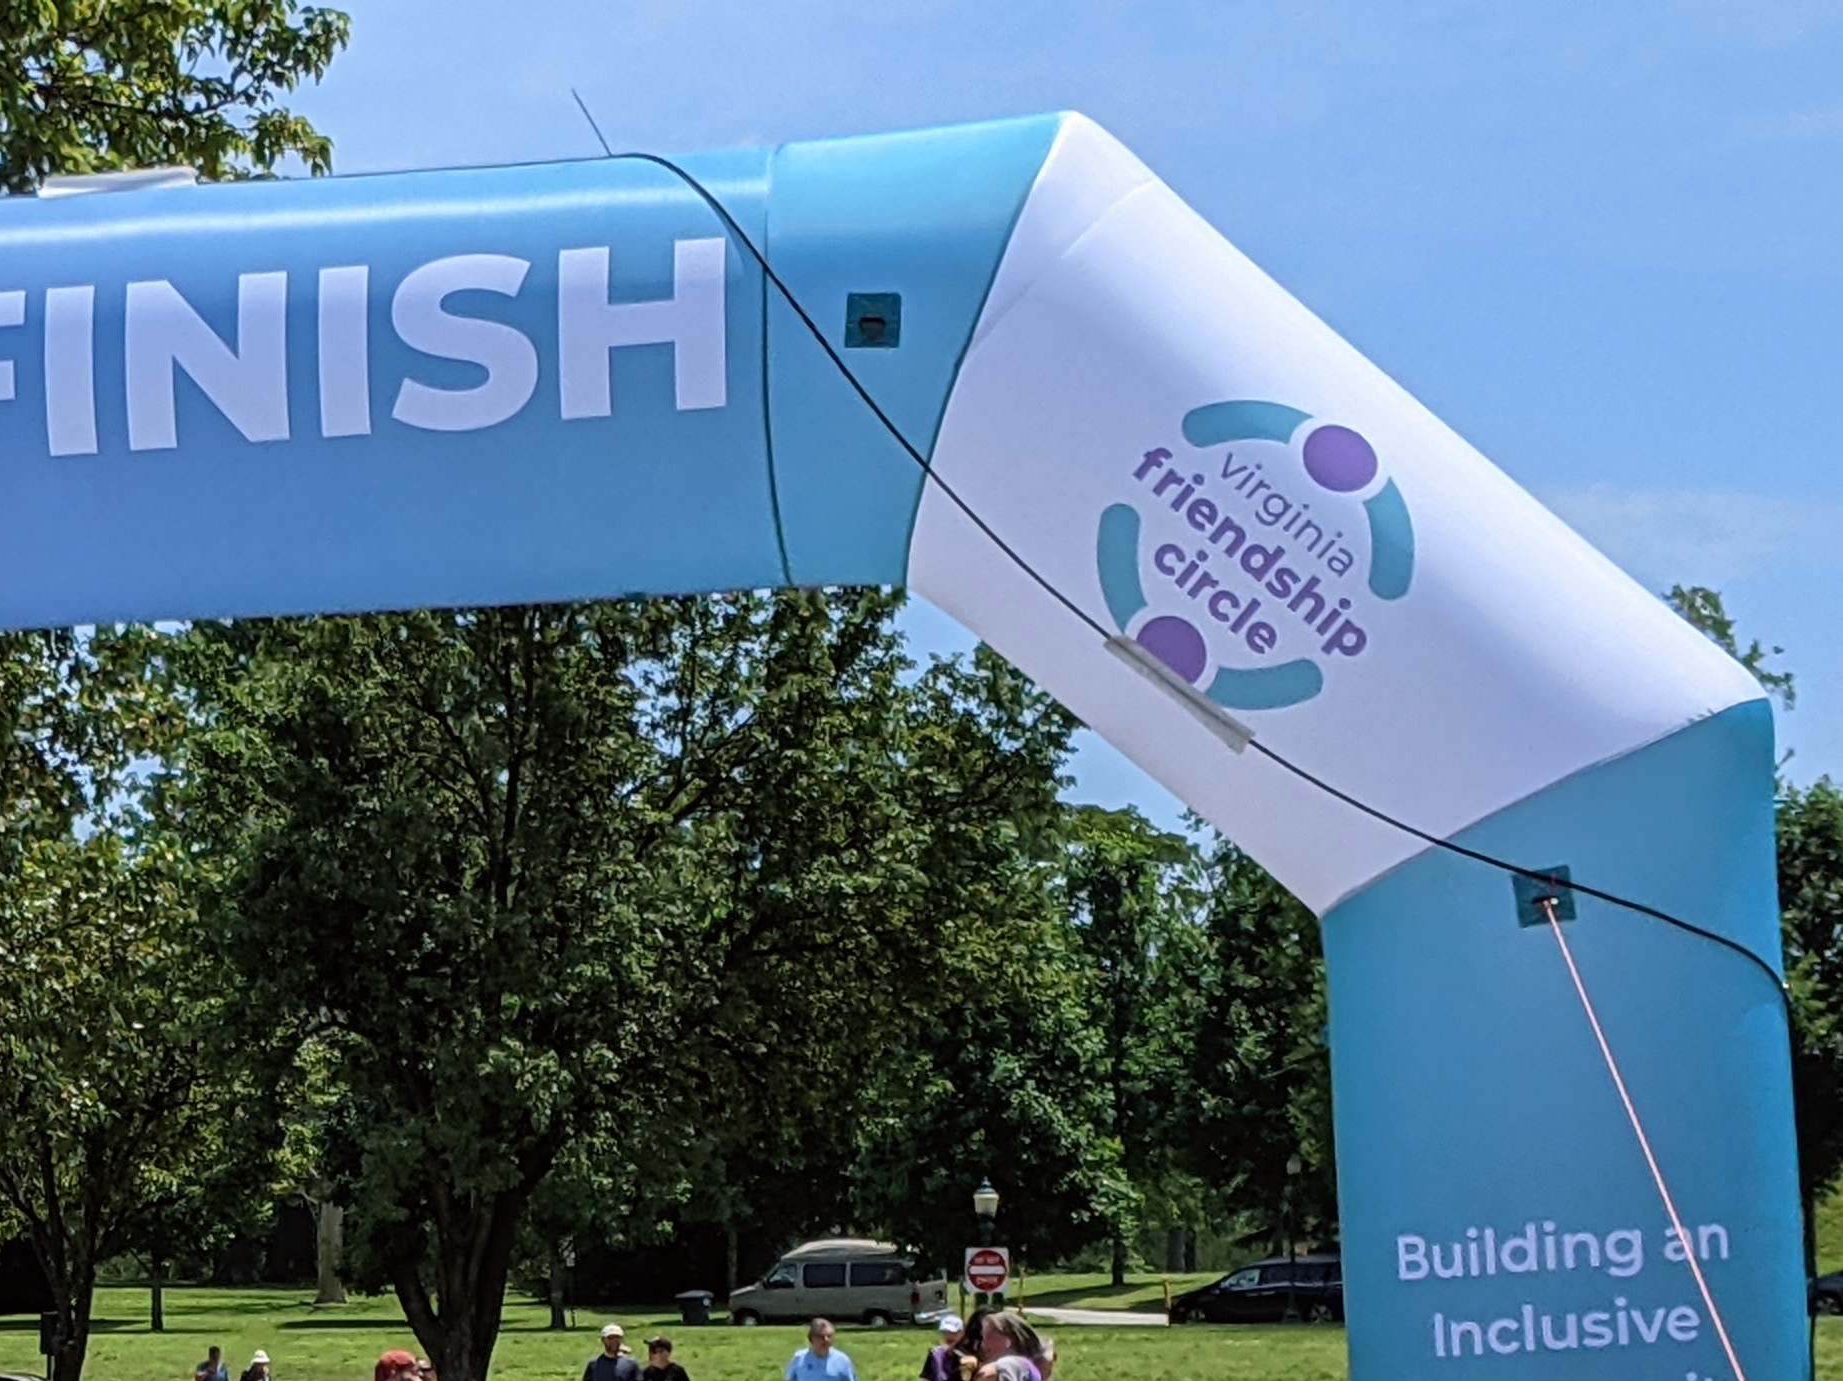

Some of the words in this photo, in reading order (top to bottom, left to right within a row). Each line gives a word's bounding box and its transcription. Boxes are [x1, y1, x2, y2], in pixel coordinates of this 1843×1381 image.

[1132, 446, 1368, 657] friendship
[1220, 452, 1355, 578] virginia
[1153, 542, 1278, 655] circle
[1396, 1220, 1644, 1281] Building
[1663, 1222, 1730, 1262] an
[1433, 1297, 1700, 1358] Inclusive
